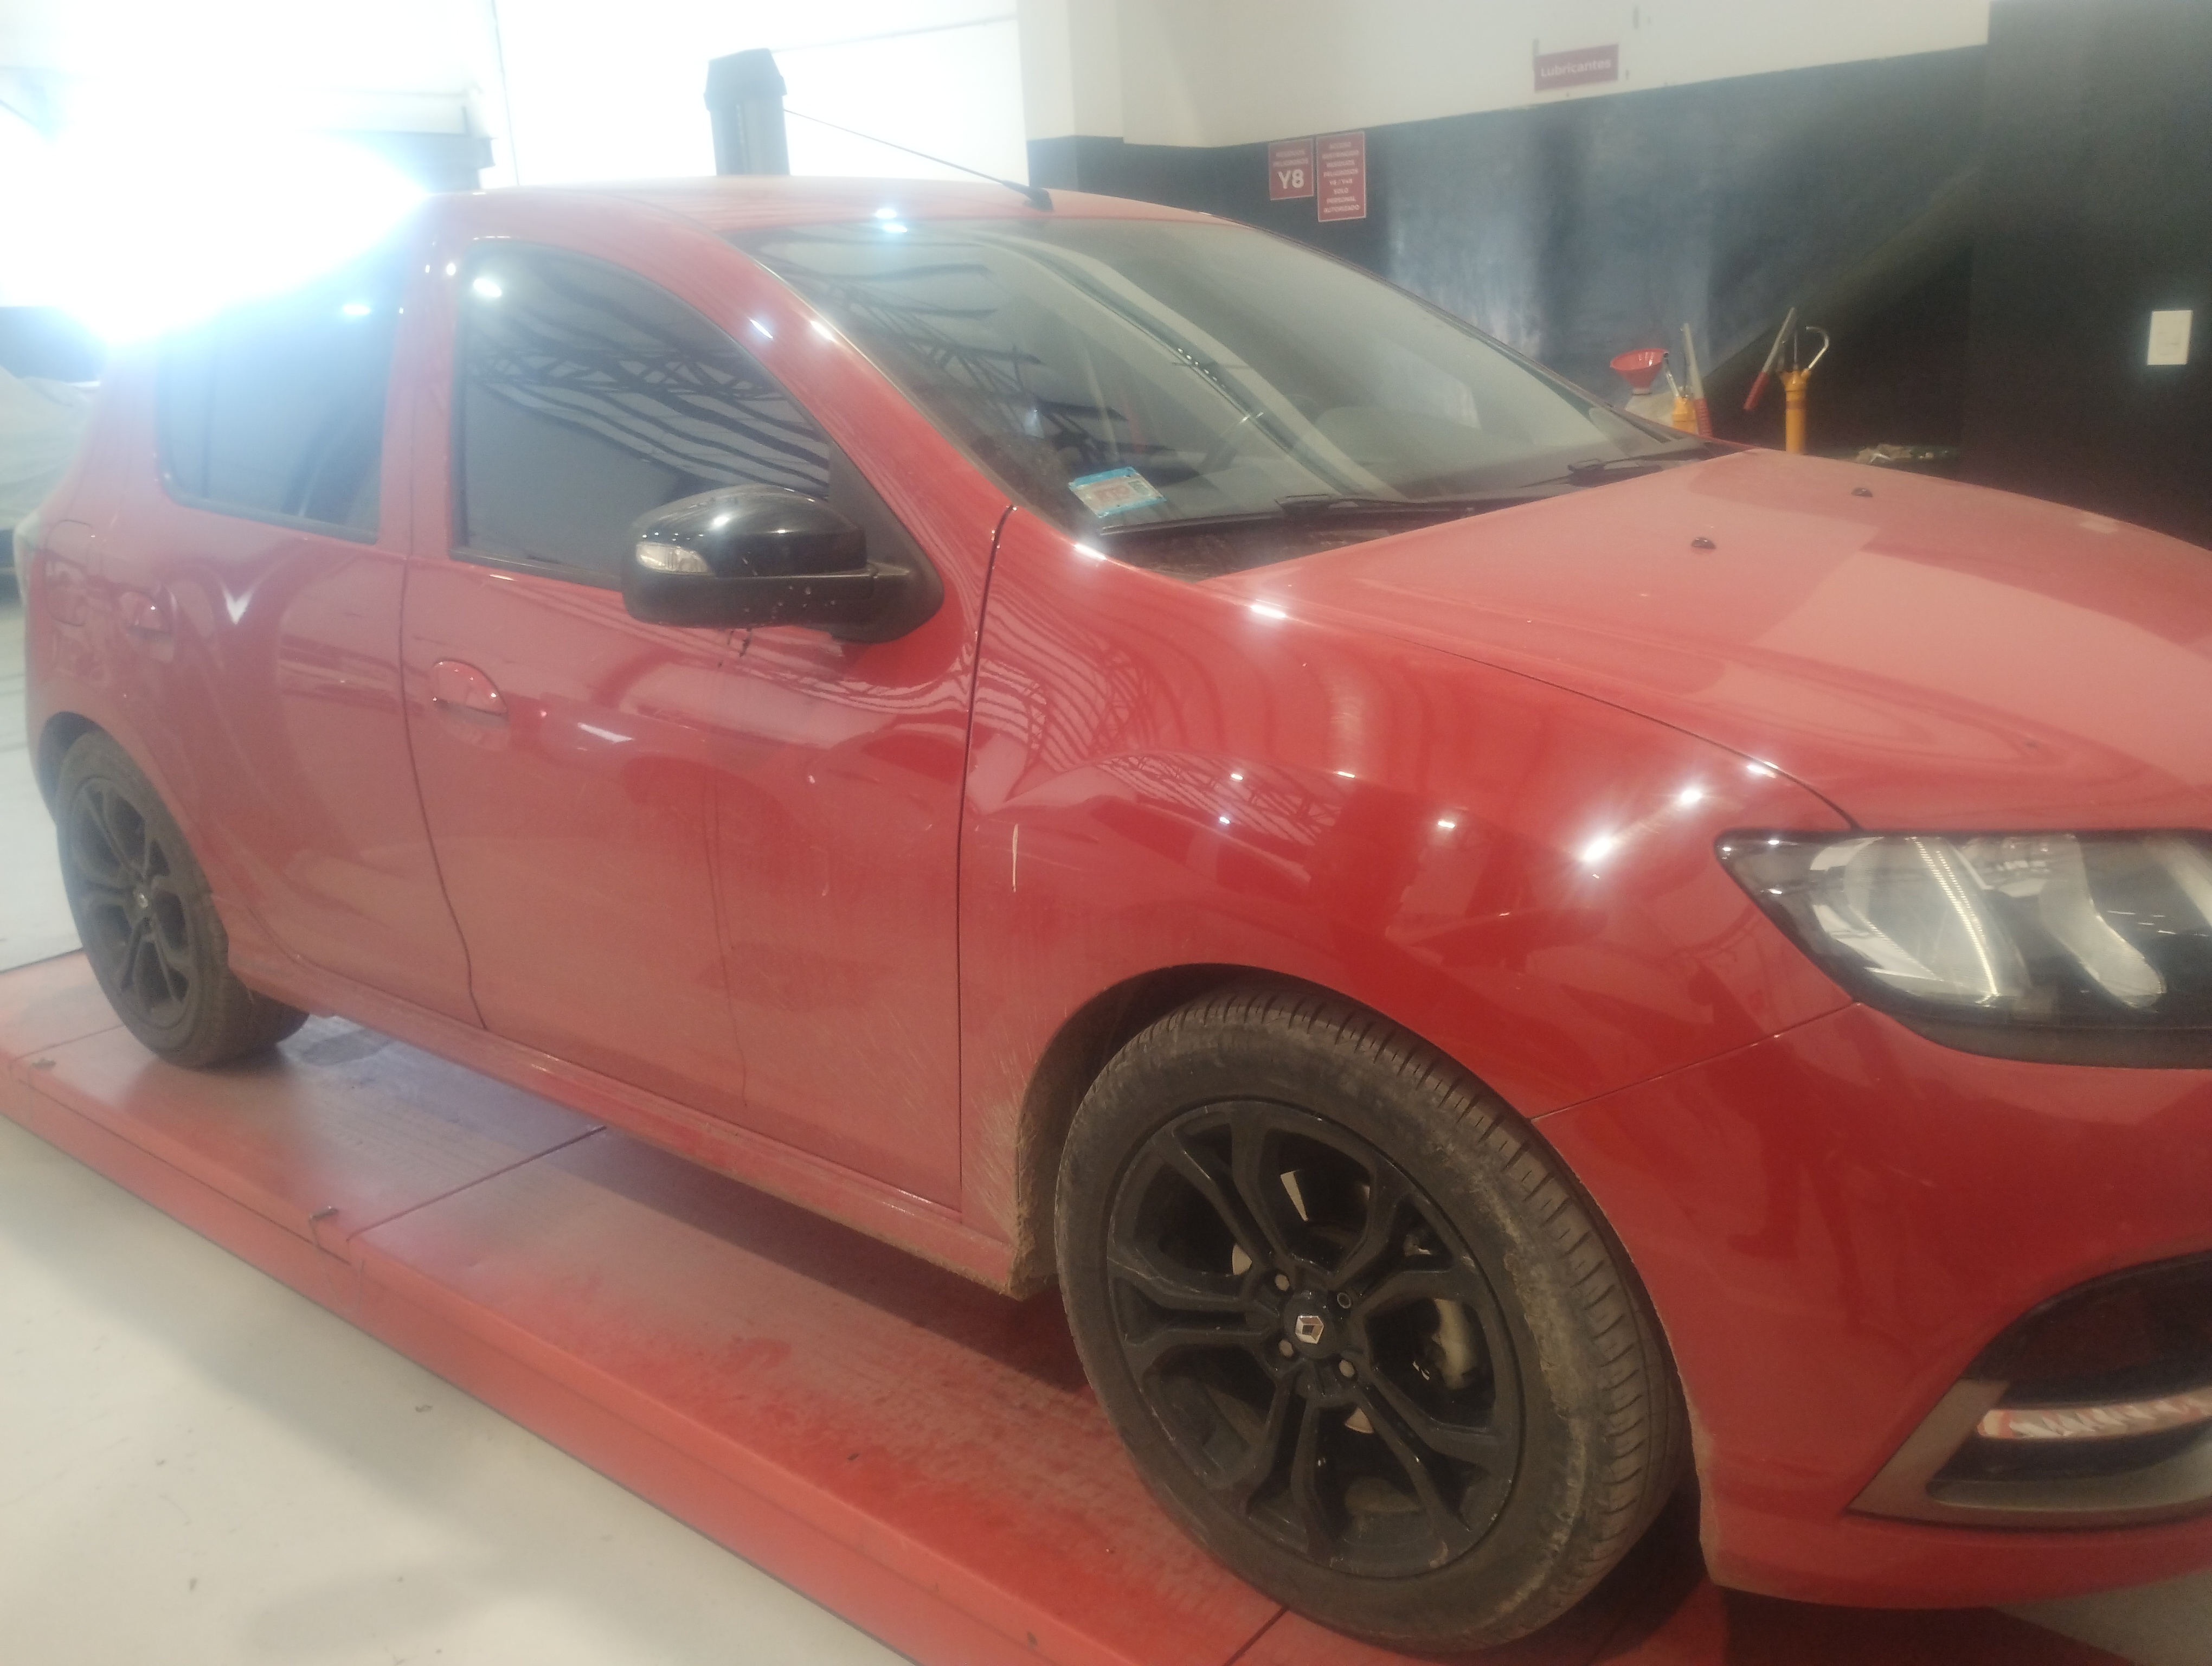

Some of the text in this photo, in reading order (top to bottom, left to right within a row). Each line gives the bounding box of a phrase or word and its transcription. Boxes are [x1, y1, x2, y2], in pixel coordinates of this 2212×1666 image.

[1541, 59, 1610, 76] Lubricantes
[1278, 169, 1304, 189] Y8
[1323, 204, 1360, 213] AUTORIZADO
